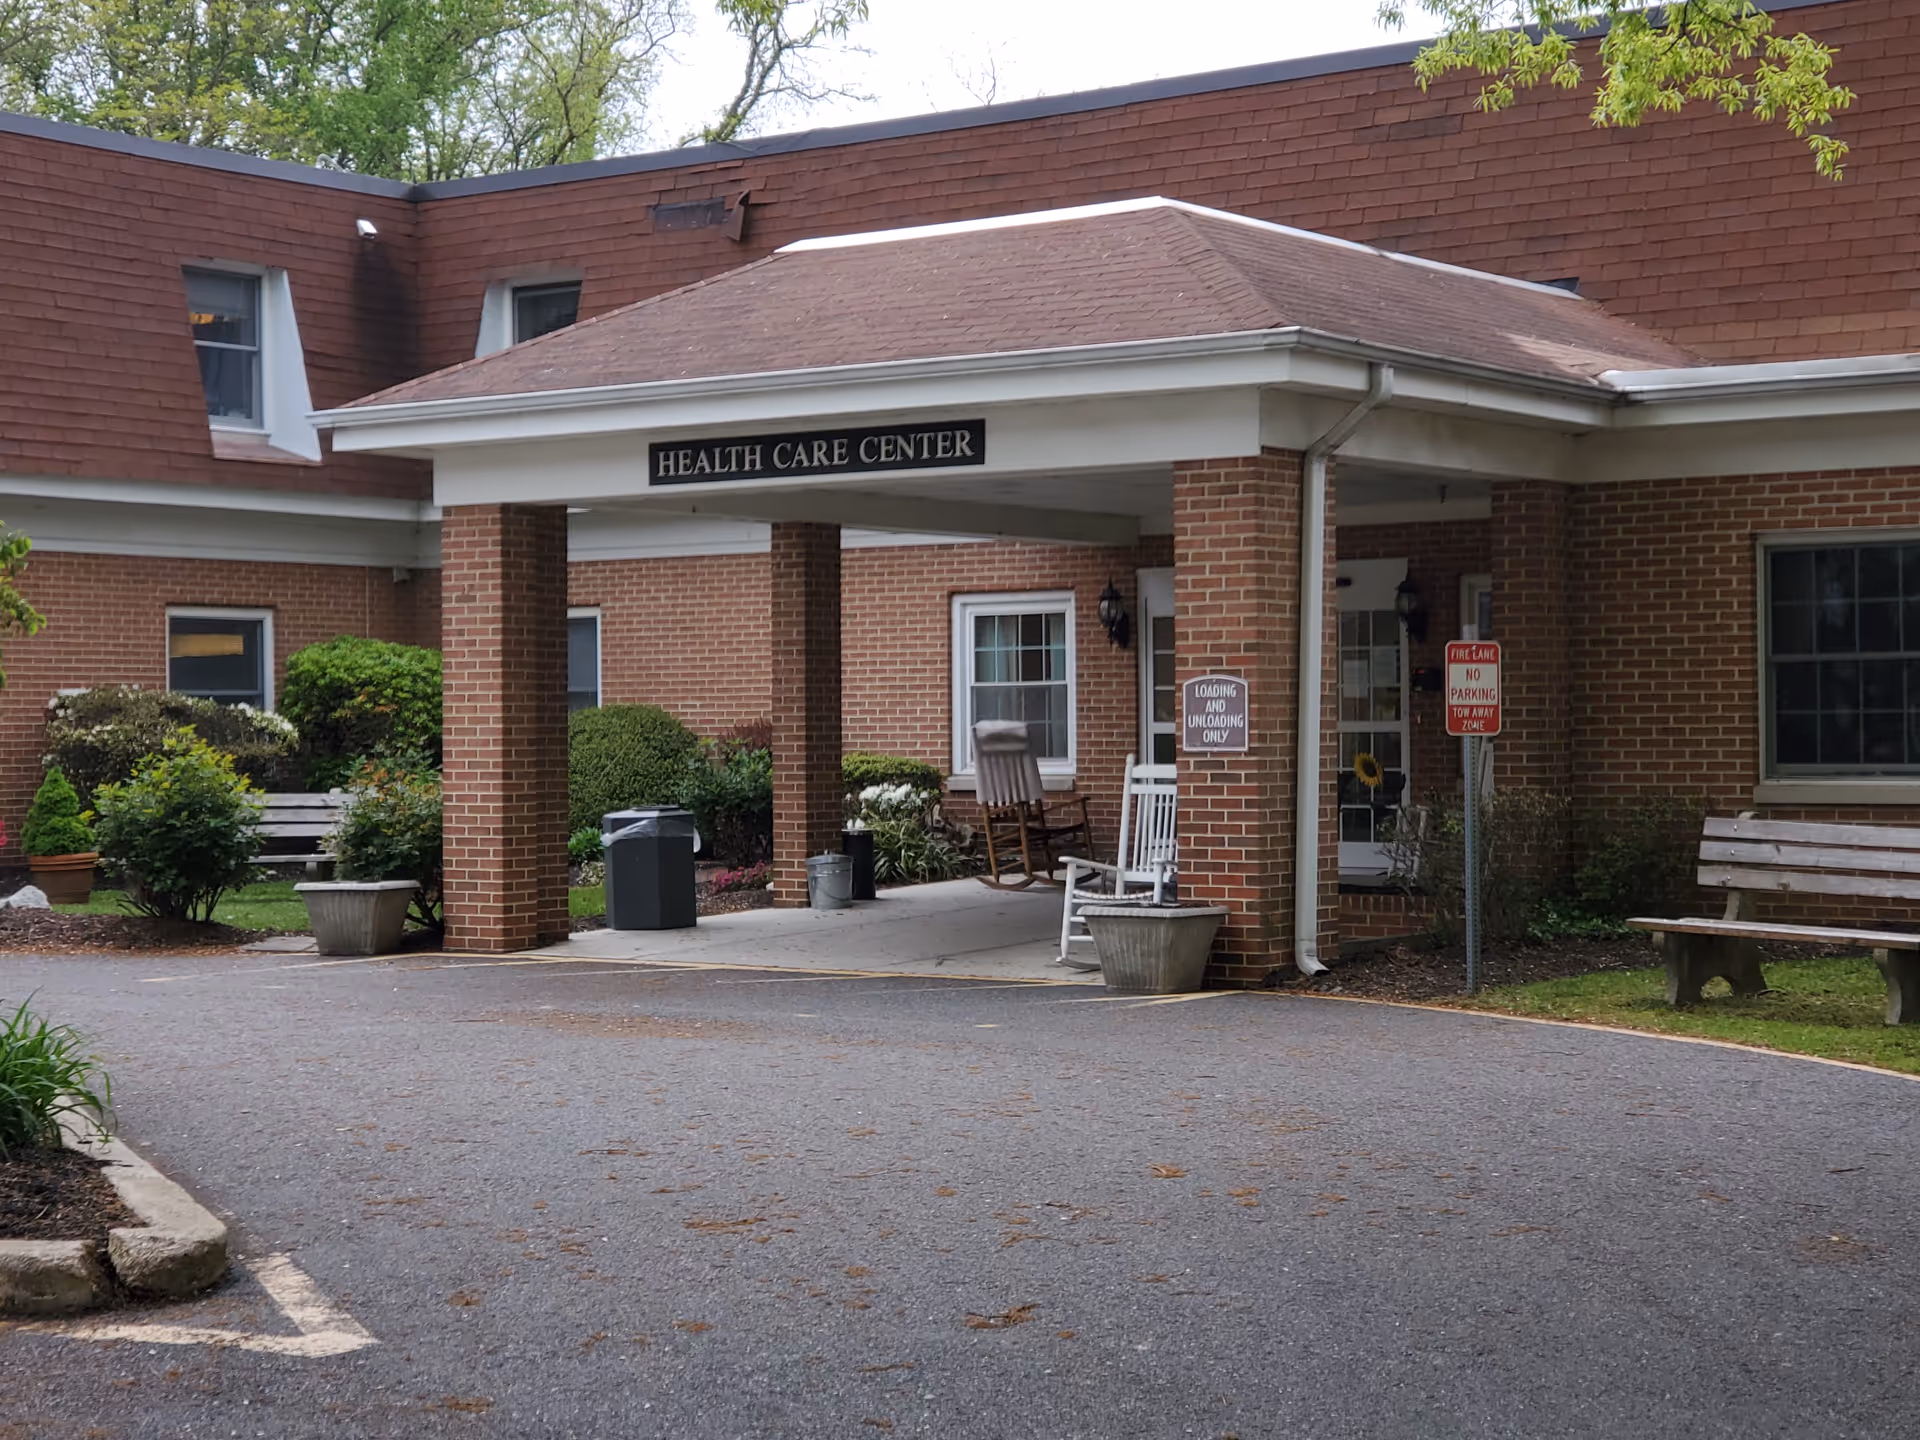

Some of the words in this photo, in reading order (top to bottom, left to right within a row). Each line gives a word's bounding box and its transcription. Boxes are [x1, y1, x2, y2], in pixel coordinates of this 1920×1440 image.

[657, 444, 763, 477] HEALTH
[772, 438, 849, 470] CARE
[859, 429, 975, 464] CENTER
[1451, 648, 1469, 660] FIRE
[1473, 648, 1495, 660] LANE
[1465, 668, 1480, 681] NO
[1195, 684, 1237, 698] LOADING
[1451, 688, 1496, 701] PARKING
[1205, 699, 1226, 713] AND
[1453, 707, 1470, 718] TOW
[1472, 707, 1494, 718] AWAY
[1188, 714, 1244, 728] UNLOADING
[1462, 721, 1485, 731] ZONE
[1202, 729, 1229, 743] ONLY
